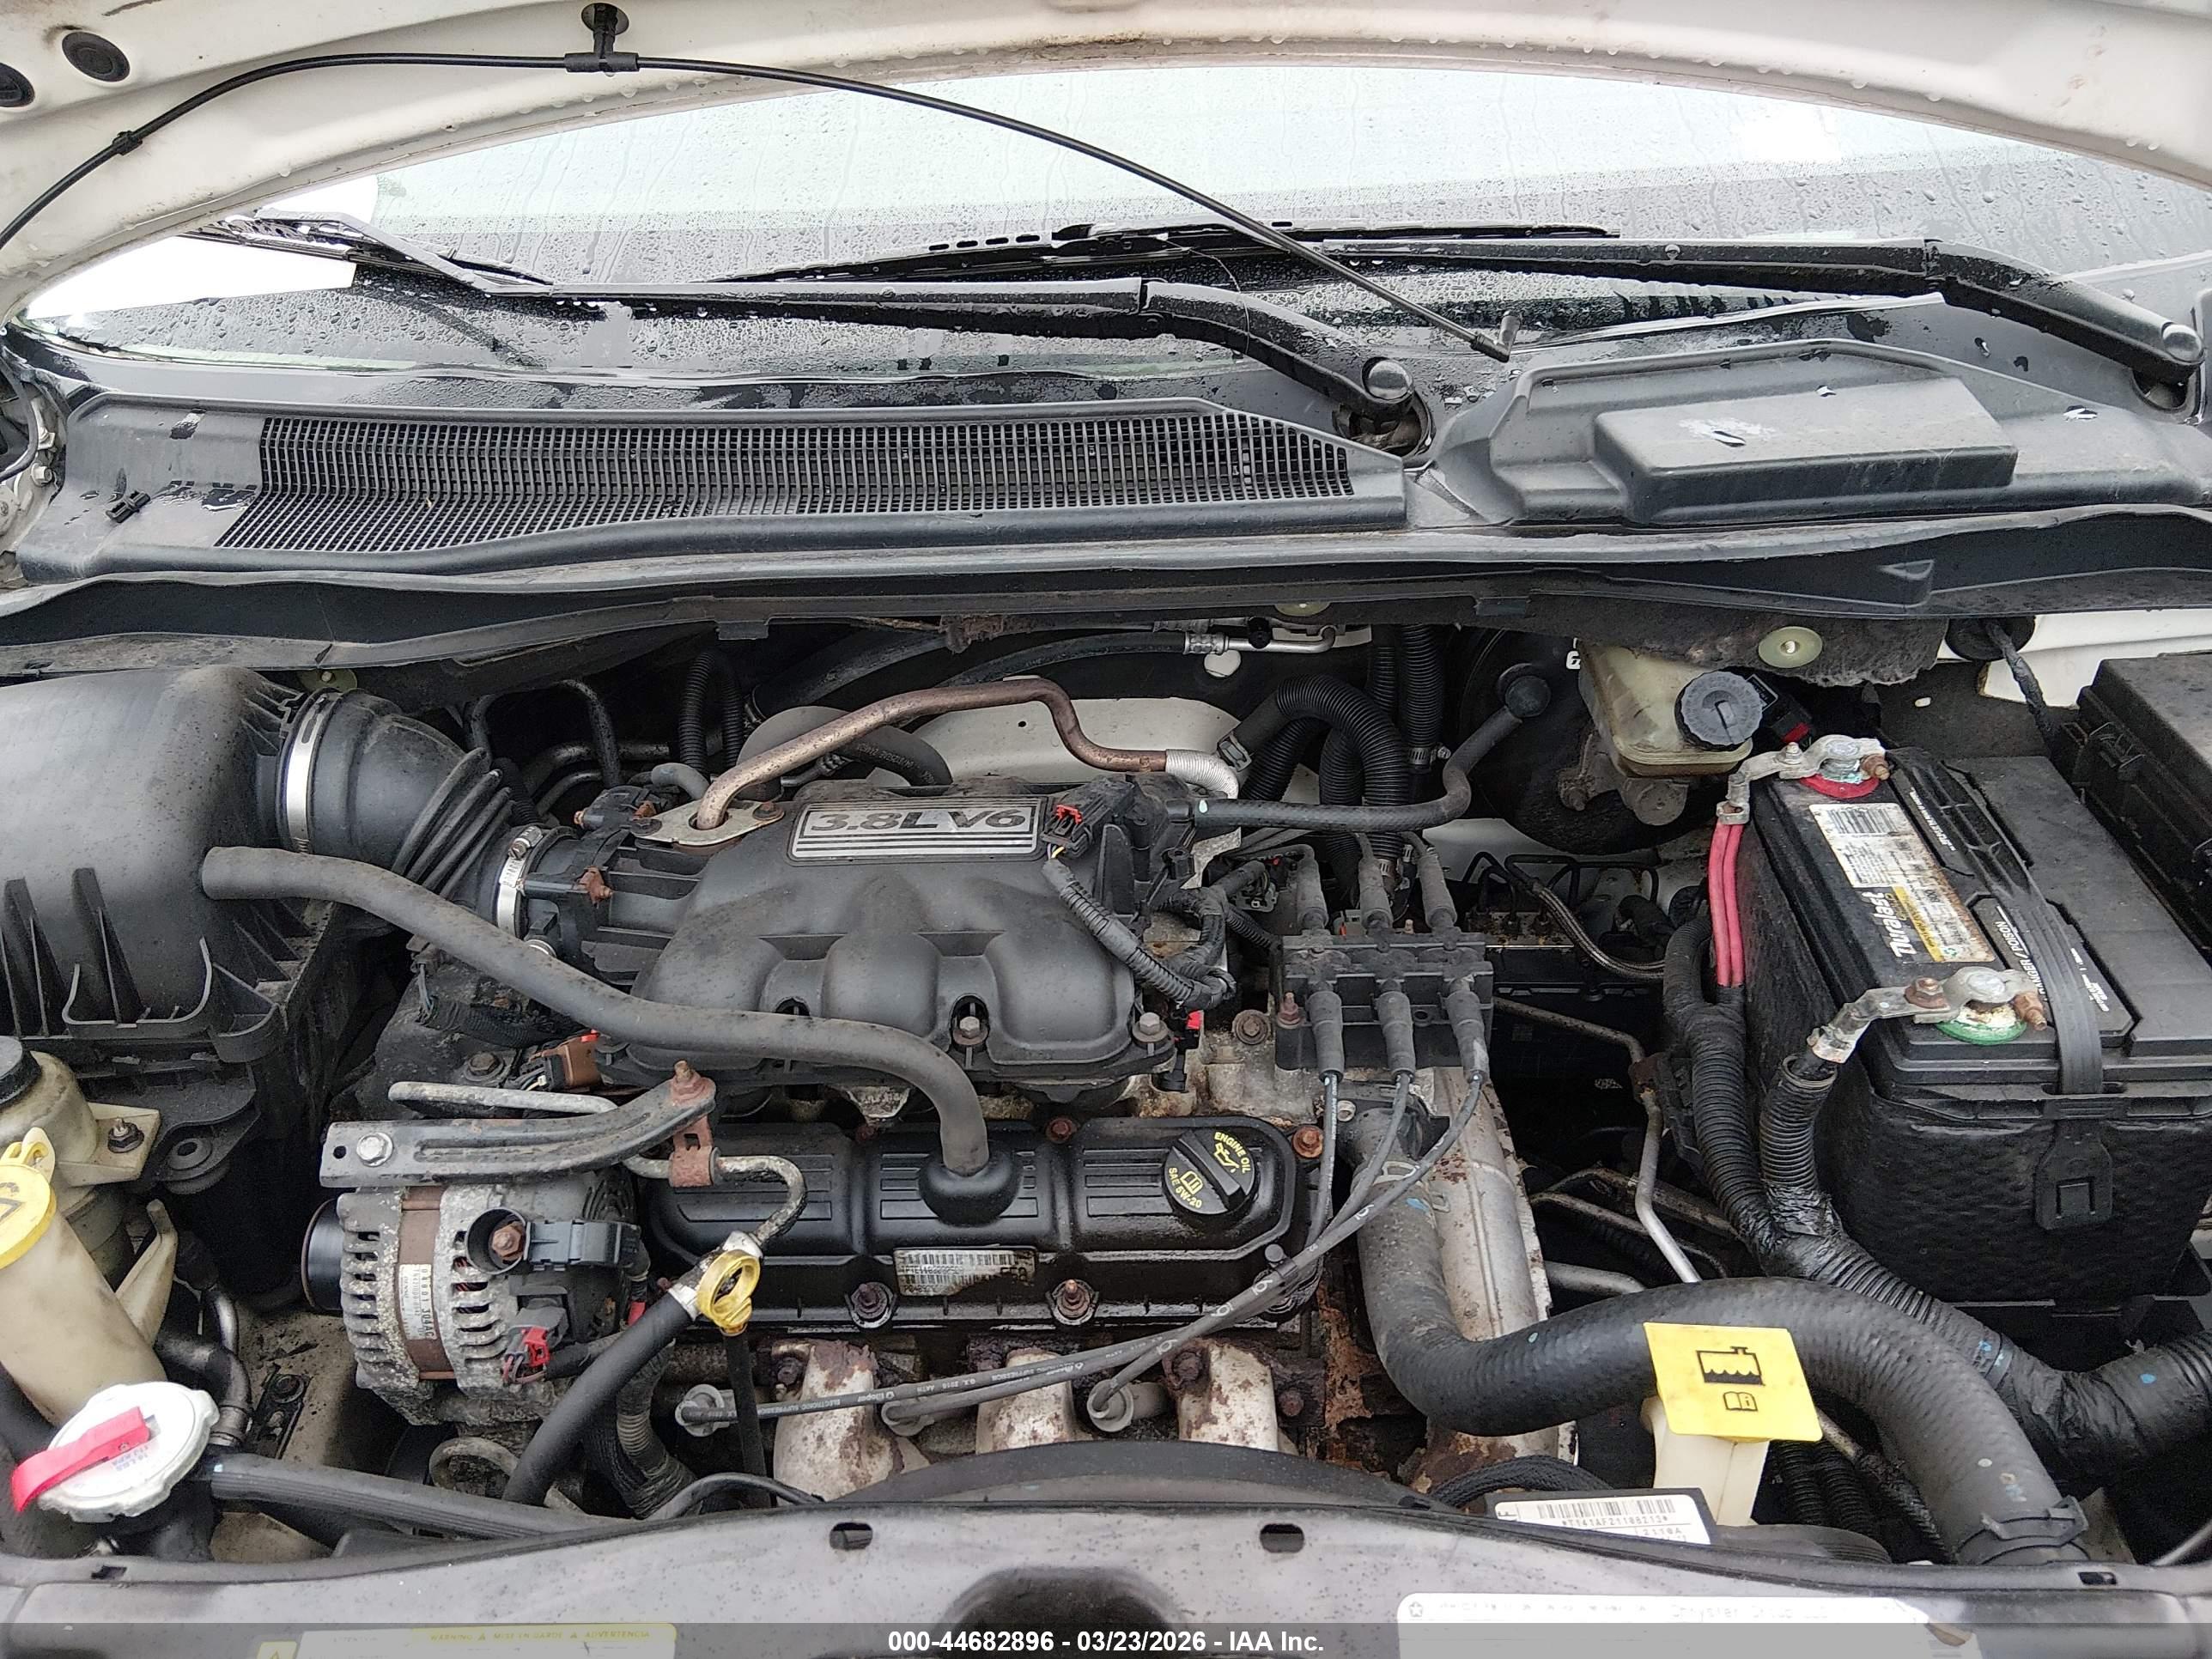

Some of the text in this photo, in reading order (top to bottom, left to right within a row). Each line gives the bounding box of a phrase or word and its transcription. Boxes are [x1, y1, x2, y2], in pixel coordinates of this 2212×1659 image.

[810, 808, 1026, 831] 3.8L V6
[1862, 890, 1918, 958] Duralast
[1996, 920, 2023, 953] POISON
[1213, 1131, 1252, 1174] ENGINE OIL
[1168, 1167, 1203, 1208] SAE 5W-20
[801, 1399, 841, 1410] ELECTRONIC
[857, 1391, 884, 1403] Mopar
